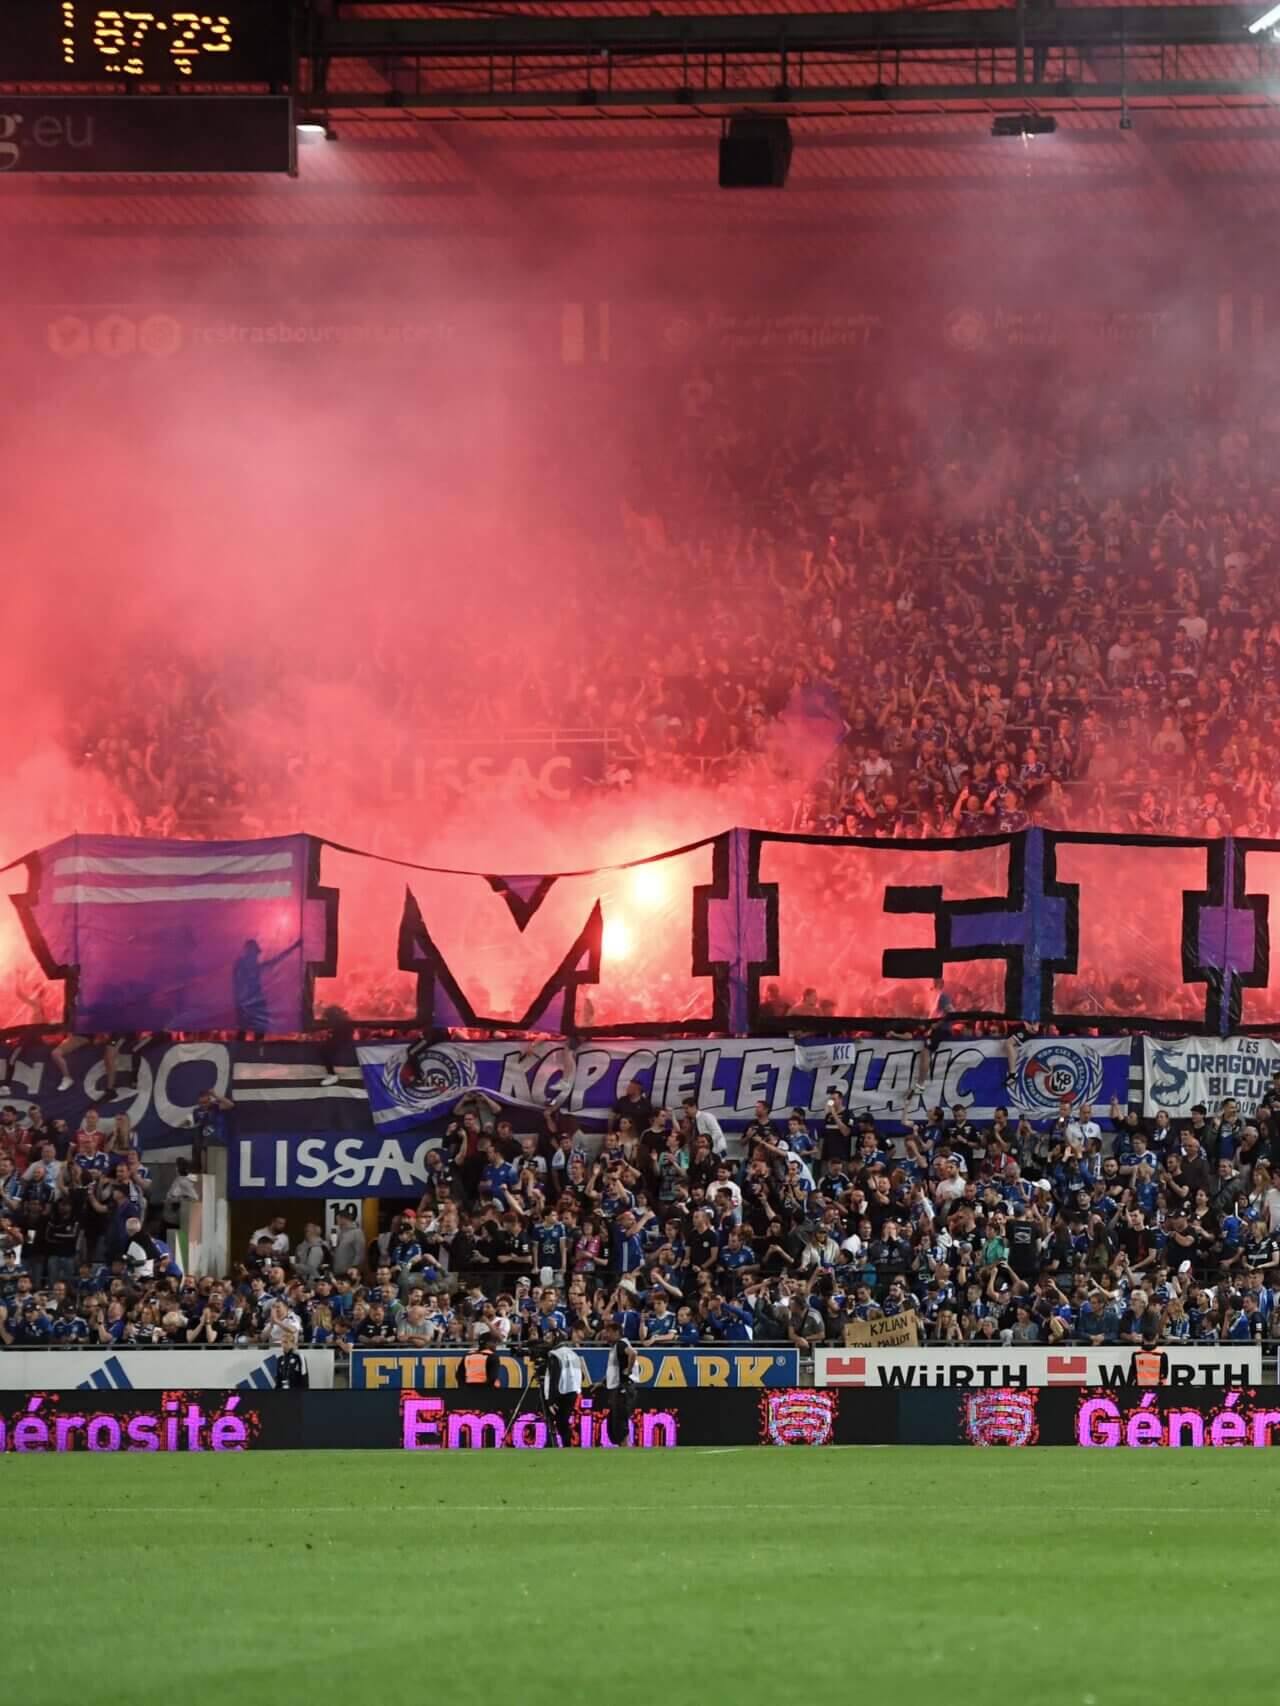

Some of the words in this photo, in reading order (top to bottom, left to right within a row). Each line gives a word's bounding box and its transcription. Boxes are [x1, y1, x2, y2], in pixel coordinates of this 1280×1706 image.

[383, 755, 572, 801] LISSAC
[1237, 1039, 1260, 1054] LES
[500, 1048, 611, 1112] KOP
[617, 1048, 727, 1111] CIEL
[735, 1047, 797, 1113] ET
[808, 1048, 986, 1113] BLANC
[239, 1137, 444, 1188] LISSAC
[869, 1315, 909, 1337] KYLIAN
[1099, 1364, 1250, 1387] WRTH
[0, 1396, 248, 1452] érosité
[403, 1398, 678, 1449] Emoin
